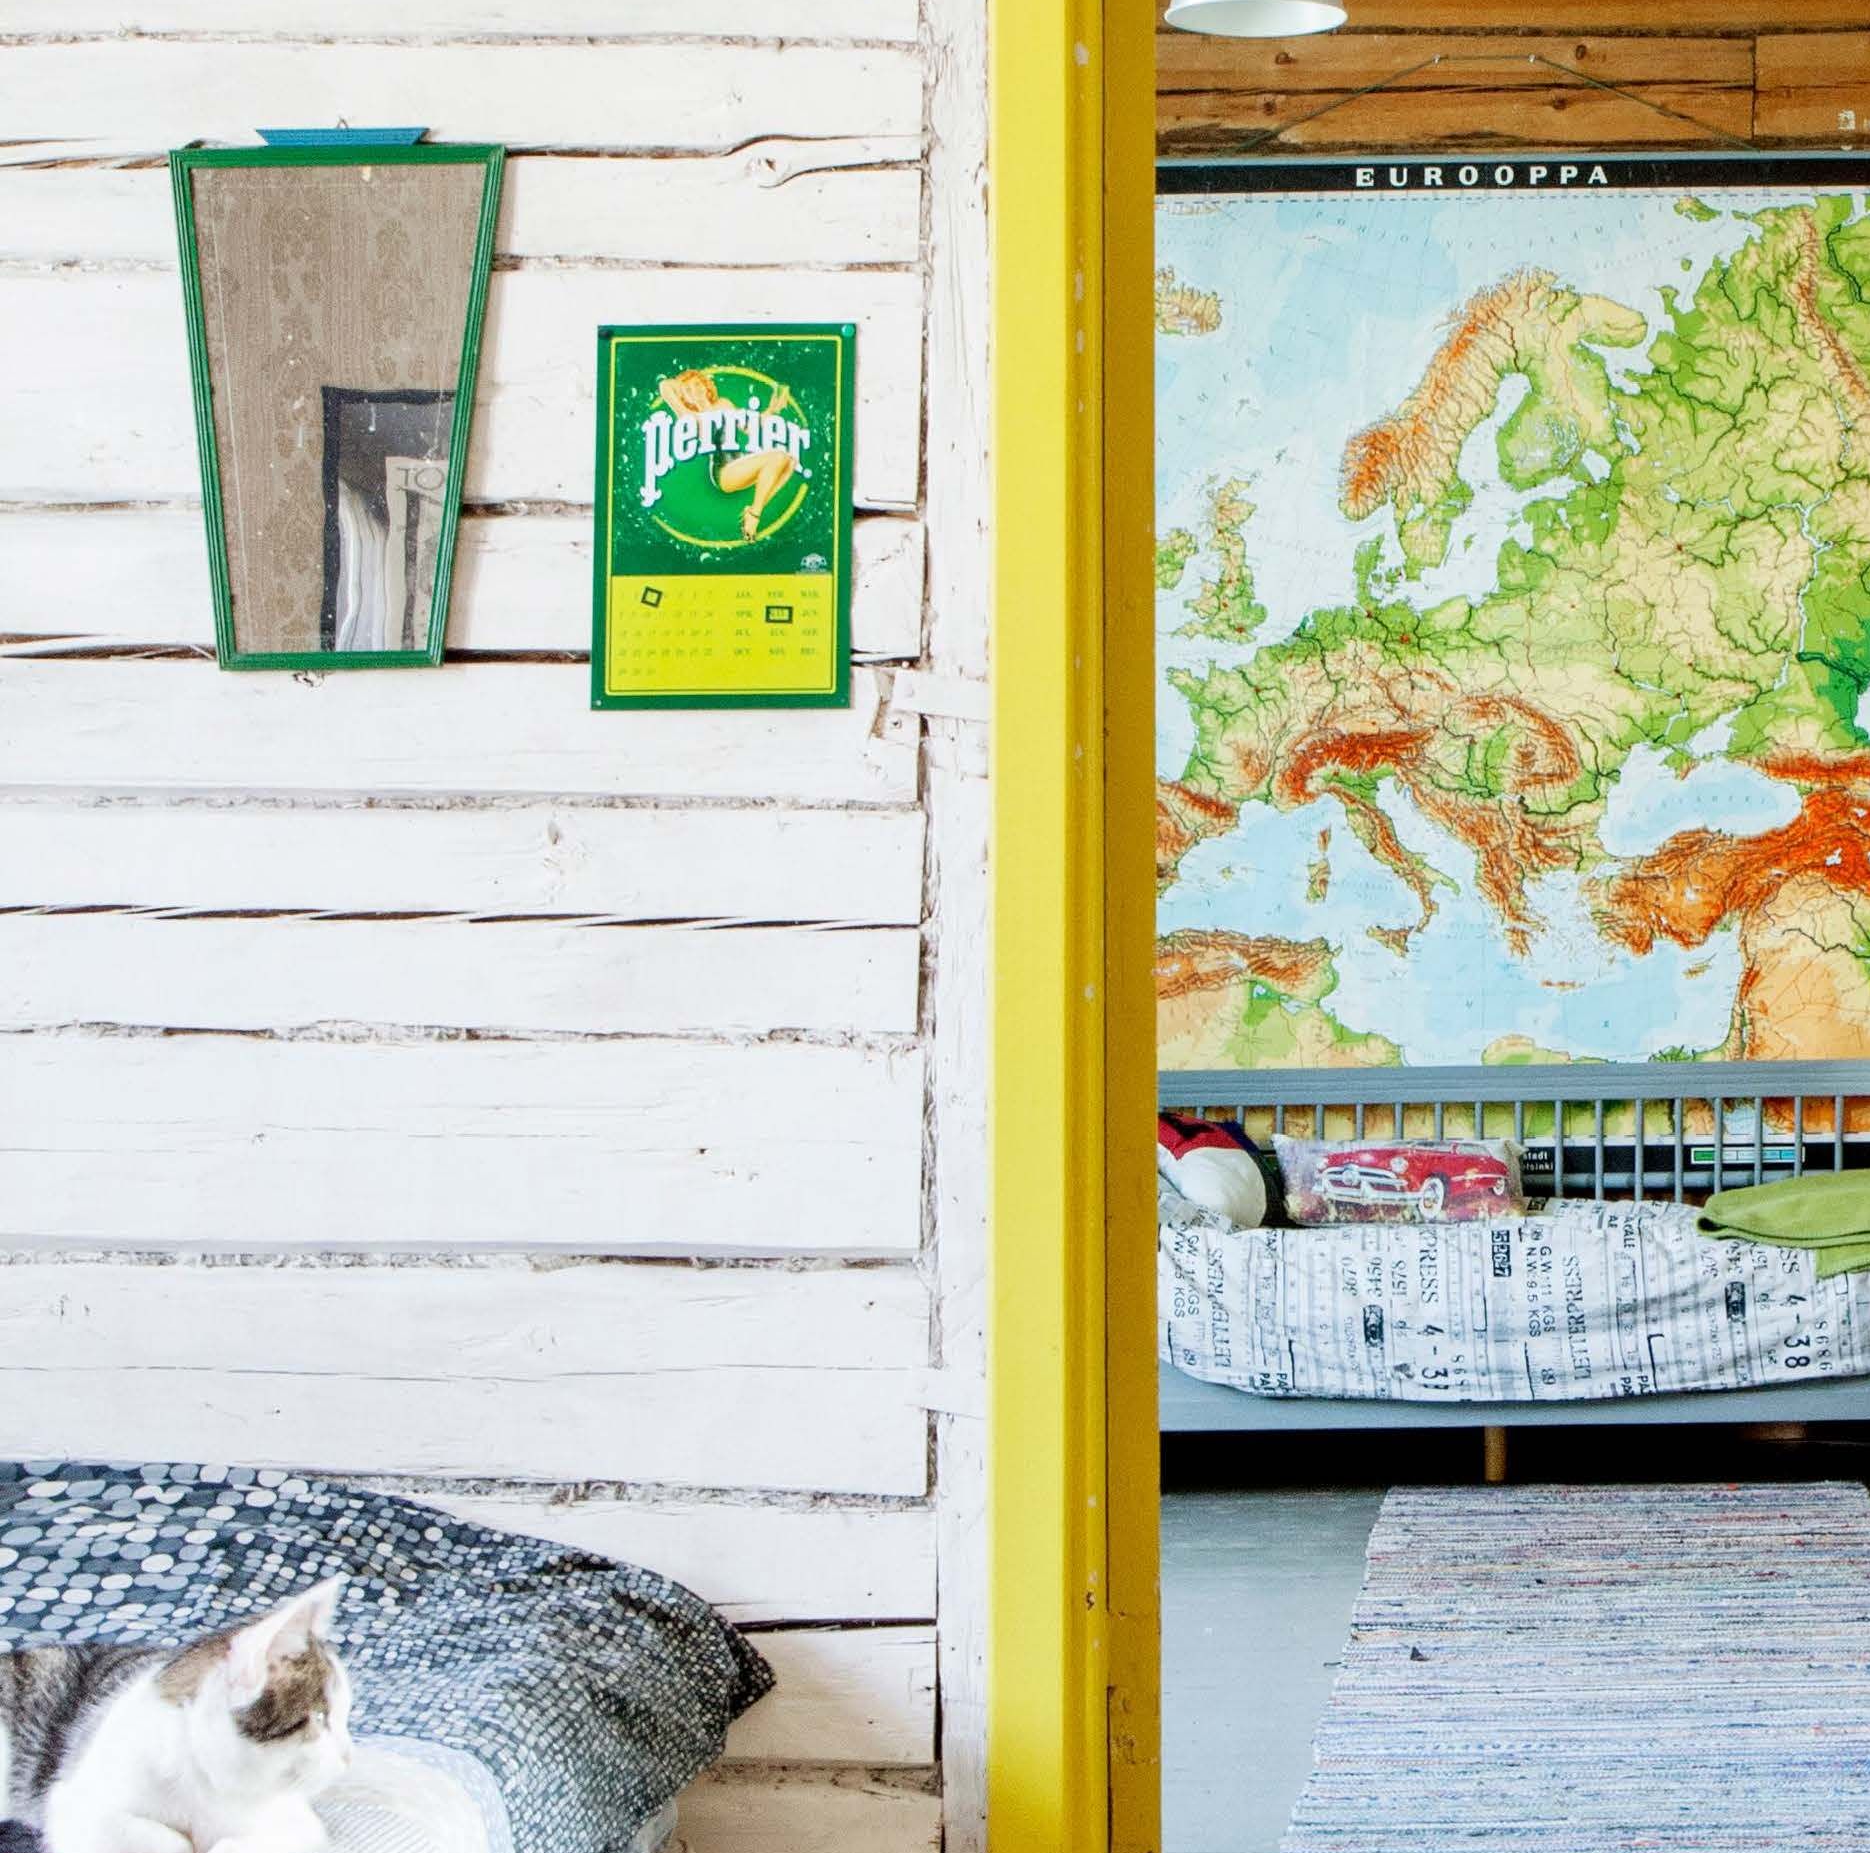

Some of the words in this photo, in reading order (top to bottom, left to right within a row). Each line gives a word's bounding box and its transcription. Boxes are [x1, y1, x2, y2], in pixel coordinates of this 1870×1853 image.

[1355, 165, 1609, 188] EUROOPPA
[1174, 1287, 1187, 1319] KGS
[1564, 1254, 1592, 1381] LETTERPRESS
[1528, 1309, 1541, 1338] KGS
